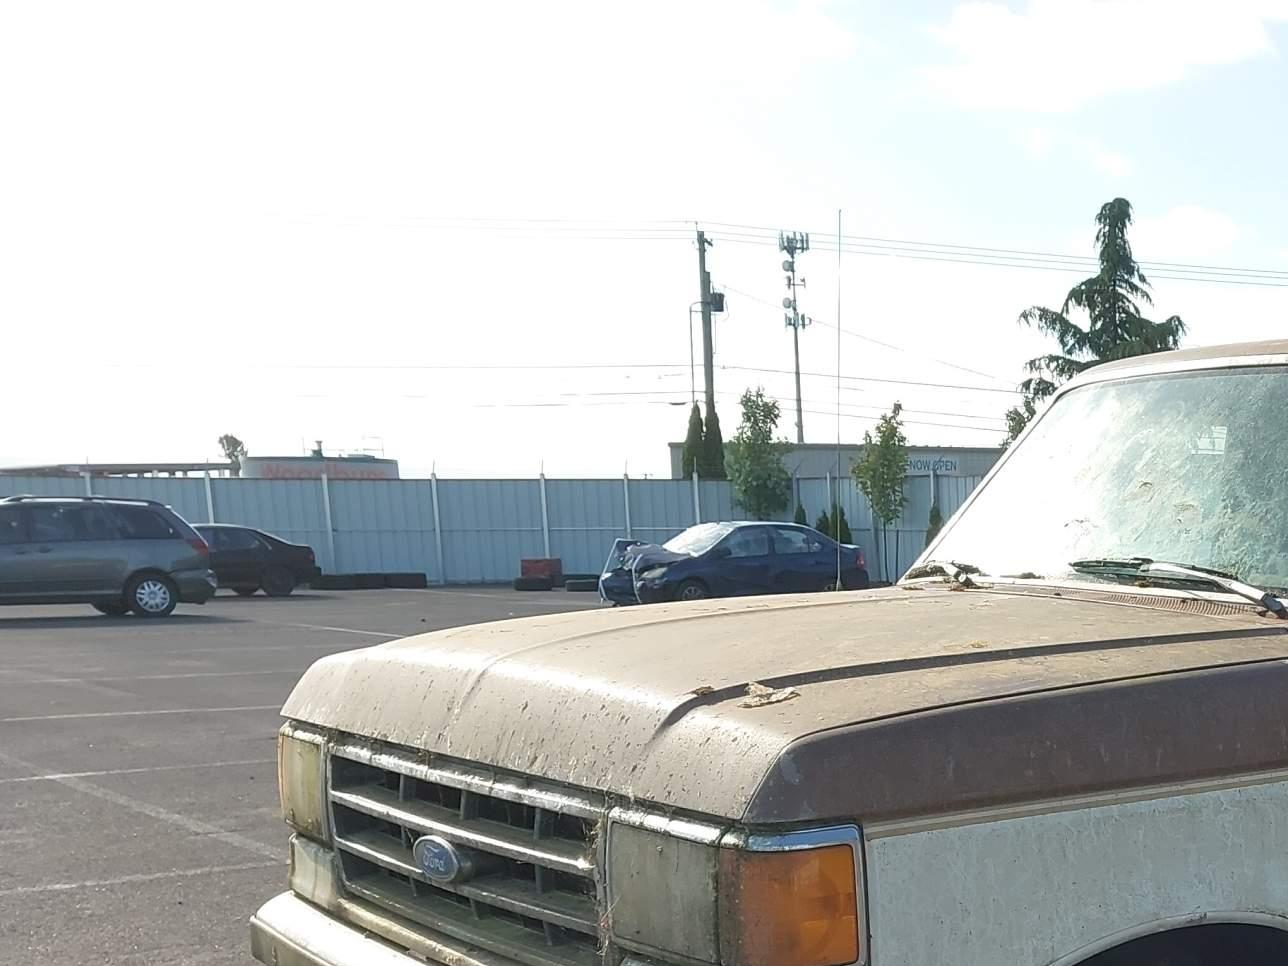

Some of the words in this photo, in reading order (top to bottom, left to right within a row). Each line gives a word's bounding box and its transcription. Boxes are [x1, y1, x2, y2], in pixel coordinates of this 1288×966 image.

[909, 460, 930, 471] NOW
[931, 460, 957, 471] OPEN
[423, 845, 447, 872] Ford
